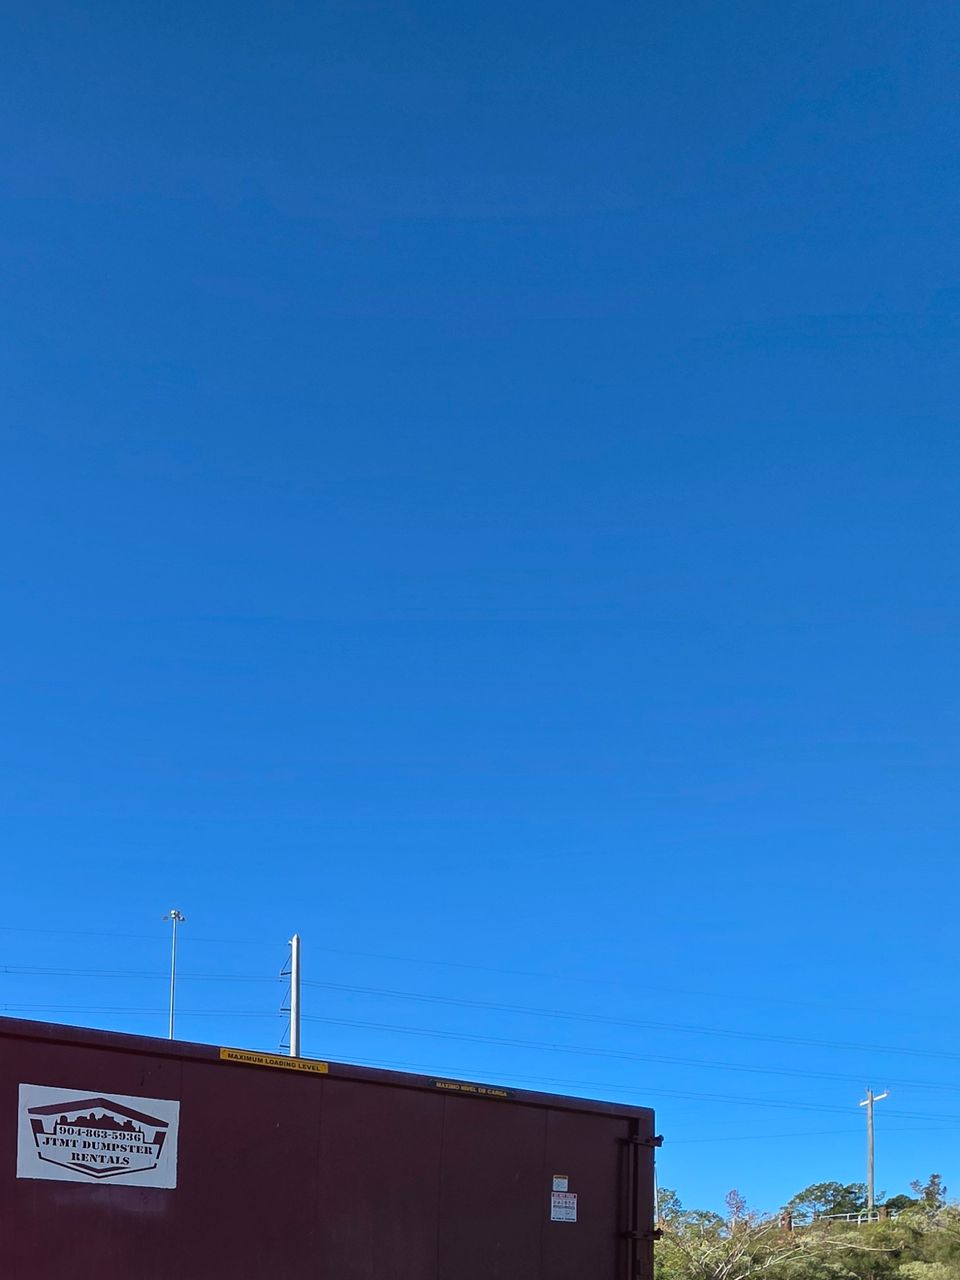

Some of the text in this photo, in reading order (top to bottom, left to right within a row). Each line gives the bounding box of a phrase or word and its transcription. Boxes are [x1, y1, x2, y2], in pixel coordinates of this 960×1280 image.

[227, 1053, 320, 1072] MAXIMUM LOADING LEVEL
[59, 1126, 141, 1142] 904-863-5936
[42, 1137, 153, 1155] JTMT DUMPSTER
[71, 1152, 130, 1166] RENTALS
